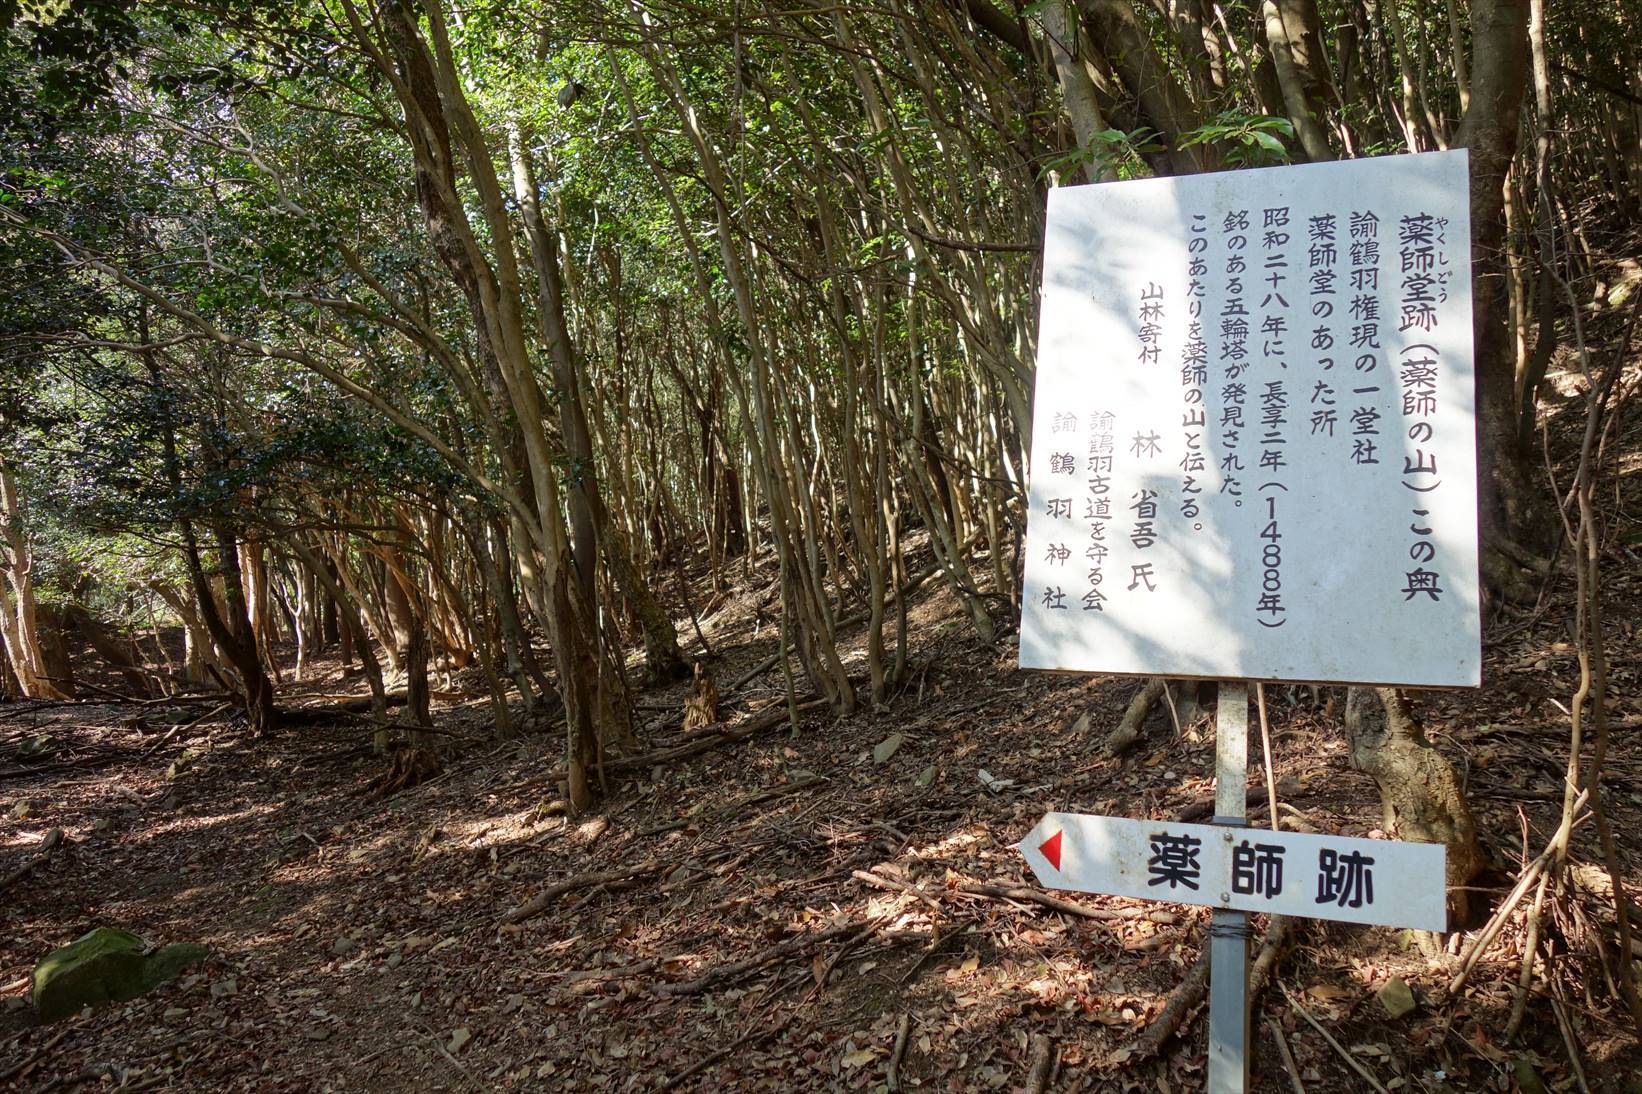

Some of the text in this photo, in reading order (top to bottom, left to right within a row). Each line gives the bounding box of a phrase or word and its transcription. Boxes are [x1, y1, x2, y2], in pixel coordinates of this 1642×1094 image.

[1138, 282, 1165, 364] 山林寄付
[1219, 209, 1250, 507] 銘のある五輪塔が発見された。
[1308, 213, 1338, 437] 薬師堂のあった所
[1349, 210, 1381, 464] 諭鶴羽権現の一堂社
[1435, 217, 1453, 303] やくしどう
[1179, 214, 1208, 531] このあたりを薬師の山と伝える。
[1081, 411, 1116, 611] 諭鶴羽古道を守る会
[1148, 831, 1374, 908] 薬師跡
